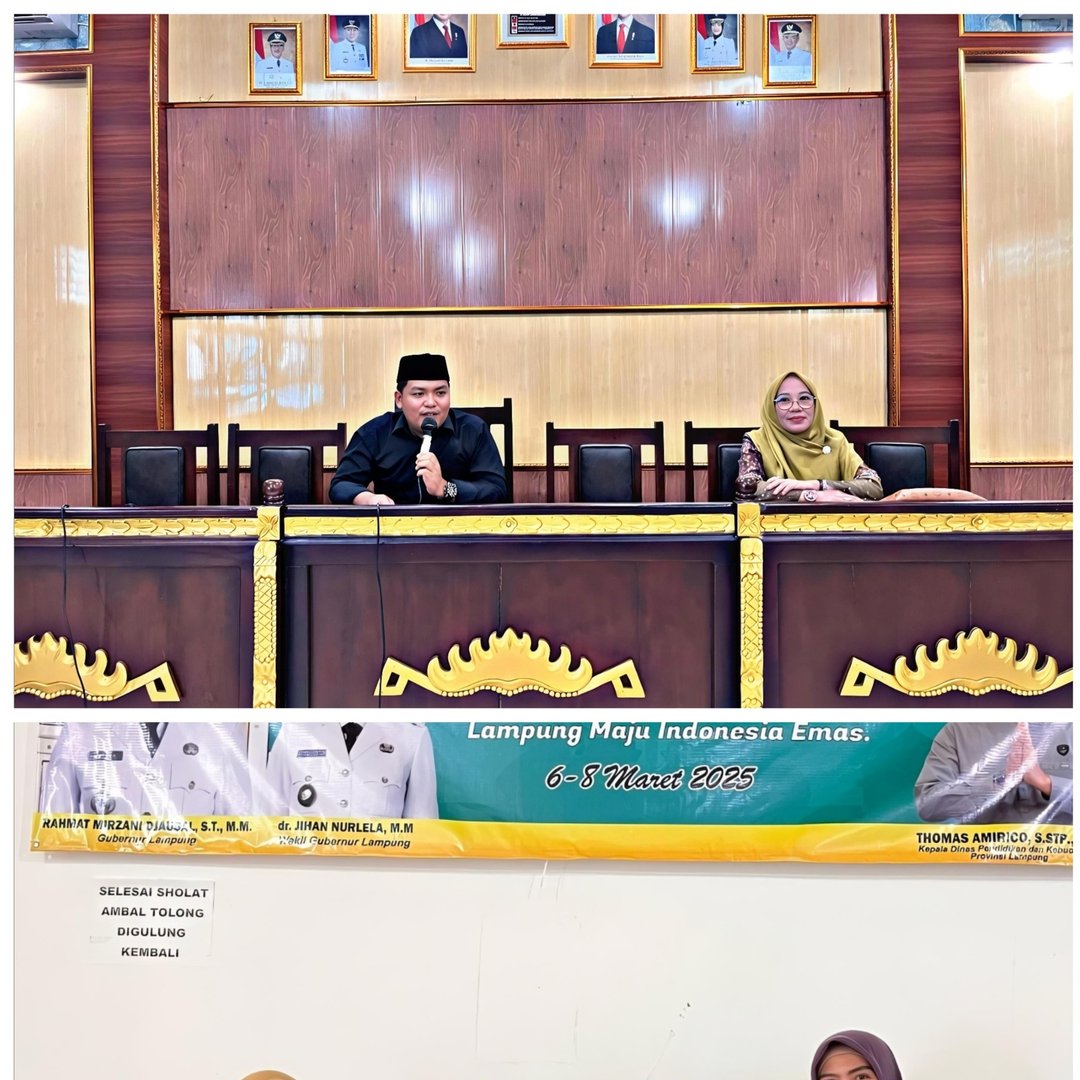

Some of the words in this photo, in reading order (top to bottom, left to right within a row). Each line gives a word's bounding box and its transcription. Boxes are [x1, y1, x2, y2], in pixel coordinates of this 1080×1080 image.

[467, 722, 583, 746] Lampung
[589, 722, 650, 746] Maju
[657, 722, 784, 743] Indonesia
[792, 722, 871, 743] Emas.
[602, 761, 685, 791] Maret
[689, 764, 757, 792] 2025
[42, 818, 90, 830] RAHMAT
[93, 819, 142, 832] MIRZANI
[201, 821, 223, 834] S.T.,
[226, 821, 252, 832] M.M.
[278, 820, 291, 831] dr.
[294, 821, 328, 832] JIHAN
[331, 822, 387, 834] NURLELA,
[309, 836, 358, 847] Gubernur
[361, 838, 411, 849] Lampung
[916, 832, 969, 844] THOMAS
[972, 832, 1031, 846] AMIRICO,
[918, 845, 948, 854] Kepala
[99, 886, 153, 898] SELESAI
[156, 887, 209, 899] SHOLAT
[101, 907, 146, 918] AMBAL
[150, 907, 205, 918] TOLONG
[117, 927, 186, 938] DIGULUNG
[121, 947, 180, 958] KEMBALI
